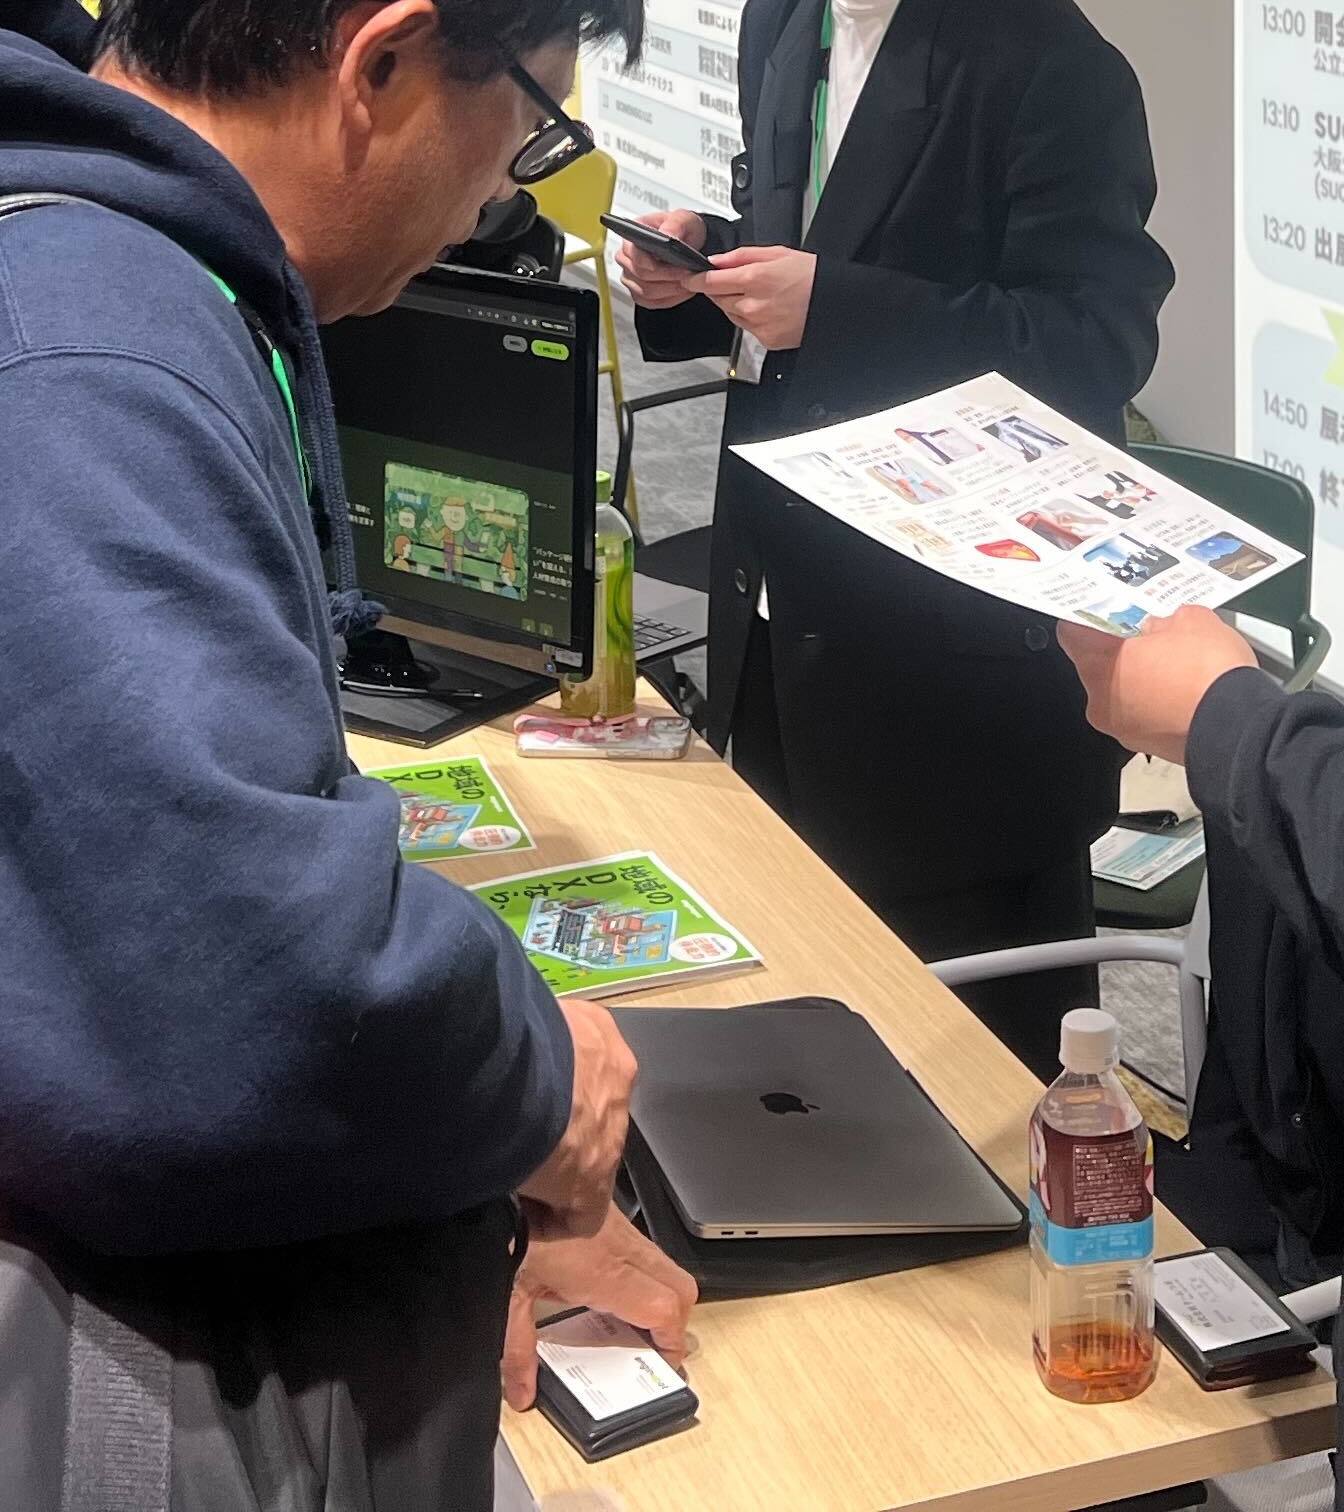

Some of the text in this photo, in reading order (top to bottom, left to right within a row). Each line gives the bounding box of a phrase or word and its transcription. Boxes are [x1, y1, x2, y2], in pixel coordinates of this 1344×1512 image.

[1261, 4, 1307, 37] 13:00
[1261, 98, 1300, 133] 13:10
[1262, 214, 1307, 252] 13:20
[1262, 388, 1308, 430] 14:50
[448, 764, 485, 800] 地域の
[619, 864, 674, 906] 地域の
